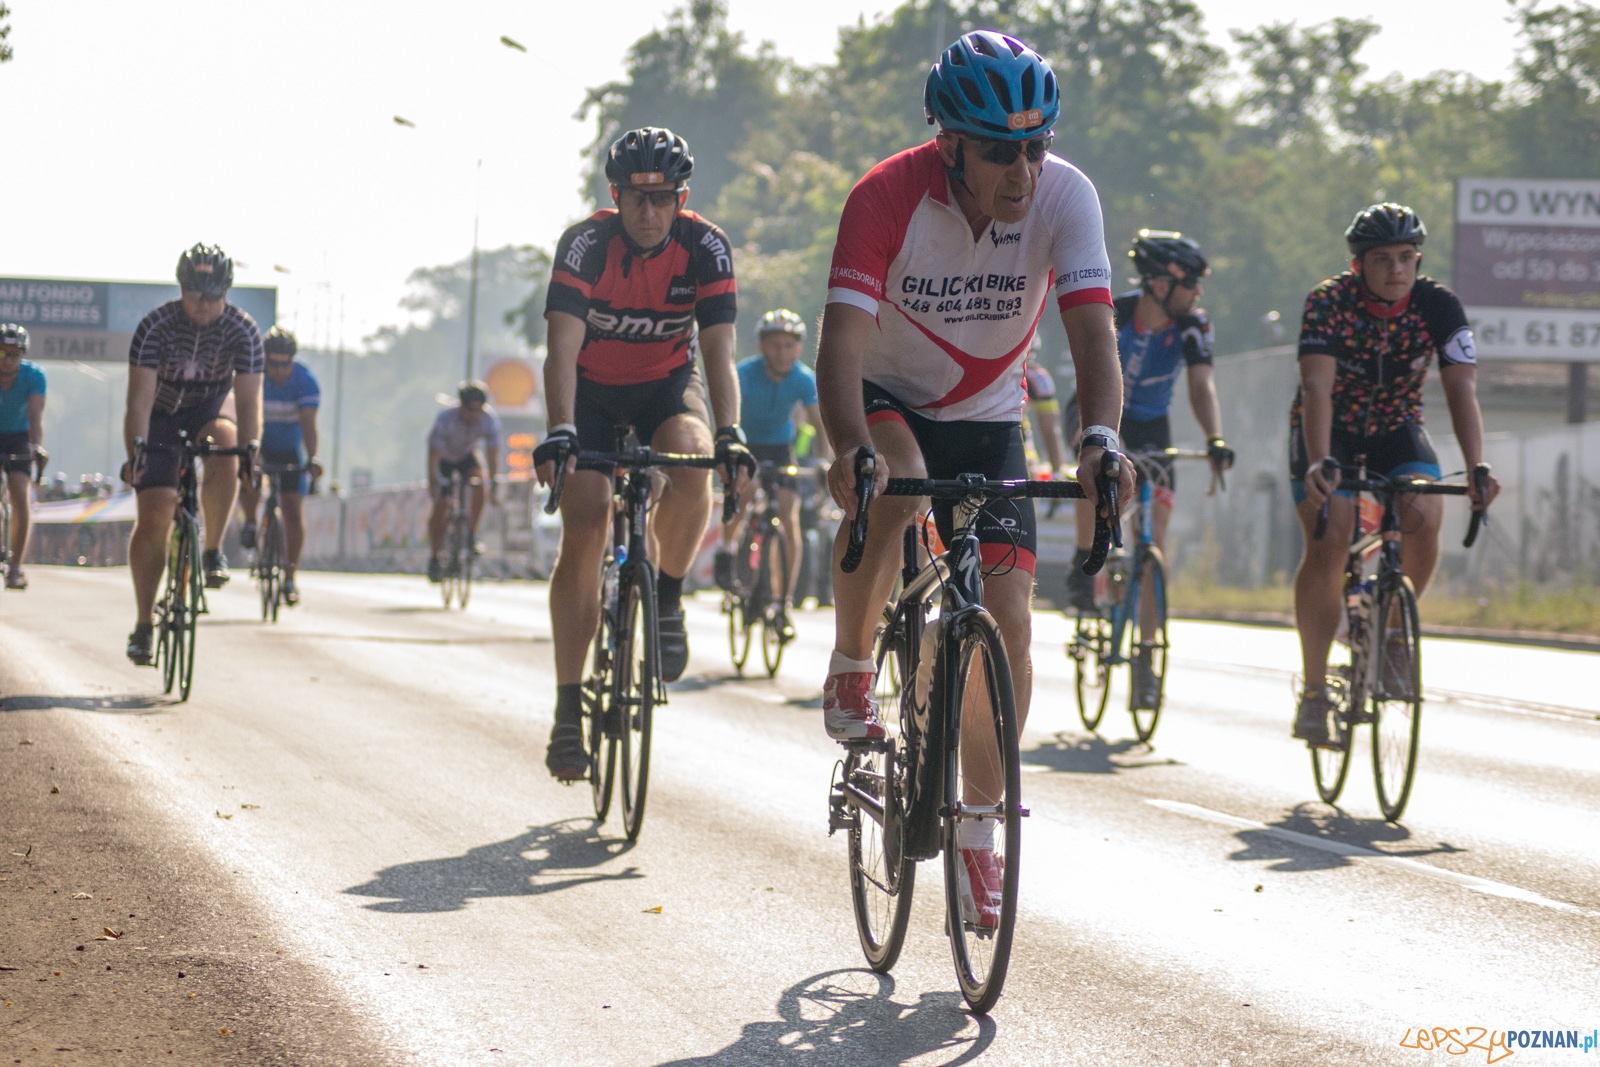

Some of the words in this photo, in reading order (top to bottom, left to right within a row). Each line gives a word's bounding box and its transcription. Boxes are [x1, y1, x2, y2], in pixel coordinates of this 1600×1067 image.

[1470, 188, 1518, 215] DO
[564, 228, 598, 272] BMC
[700, 231, 731, 273] BMC
[839, 267, 875, 288] AKCESORIA
[902, 274, 984, 297] GILICKI
[986, 273, 1027, 292] BIKE
[1079, 268, 1104, 279] CZESCI
[27, 284, 94, 304] FONDO
[902, 298, 931, 313] +48
[936, 299, 962, 313] 604
[966, 297, 991, 310] 485
[996, 297, 1022, 312] 083
[40, 304, 101, 323] SERIES
[587, 308, 691, 336] BMC
[1525, 321, 1558, 346] 61
